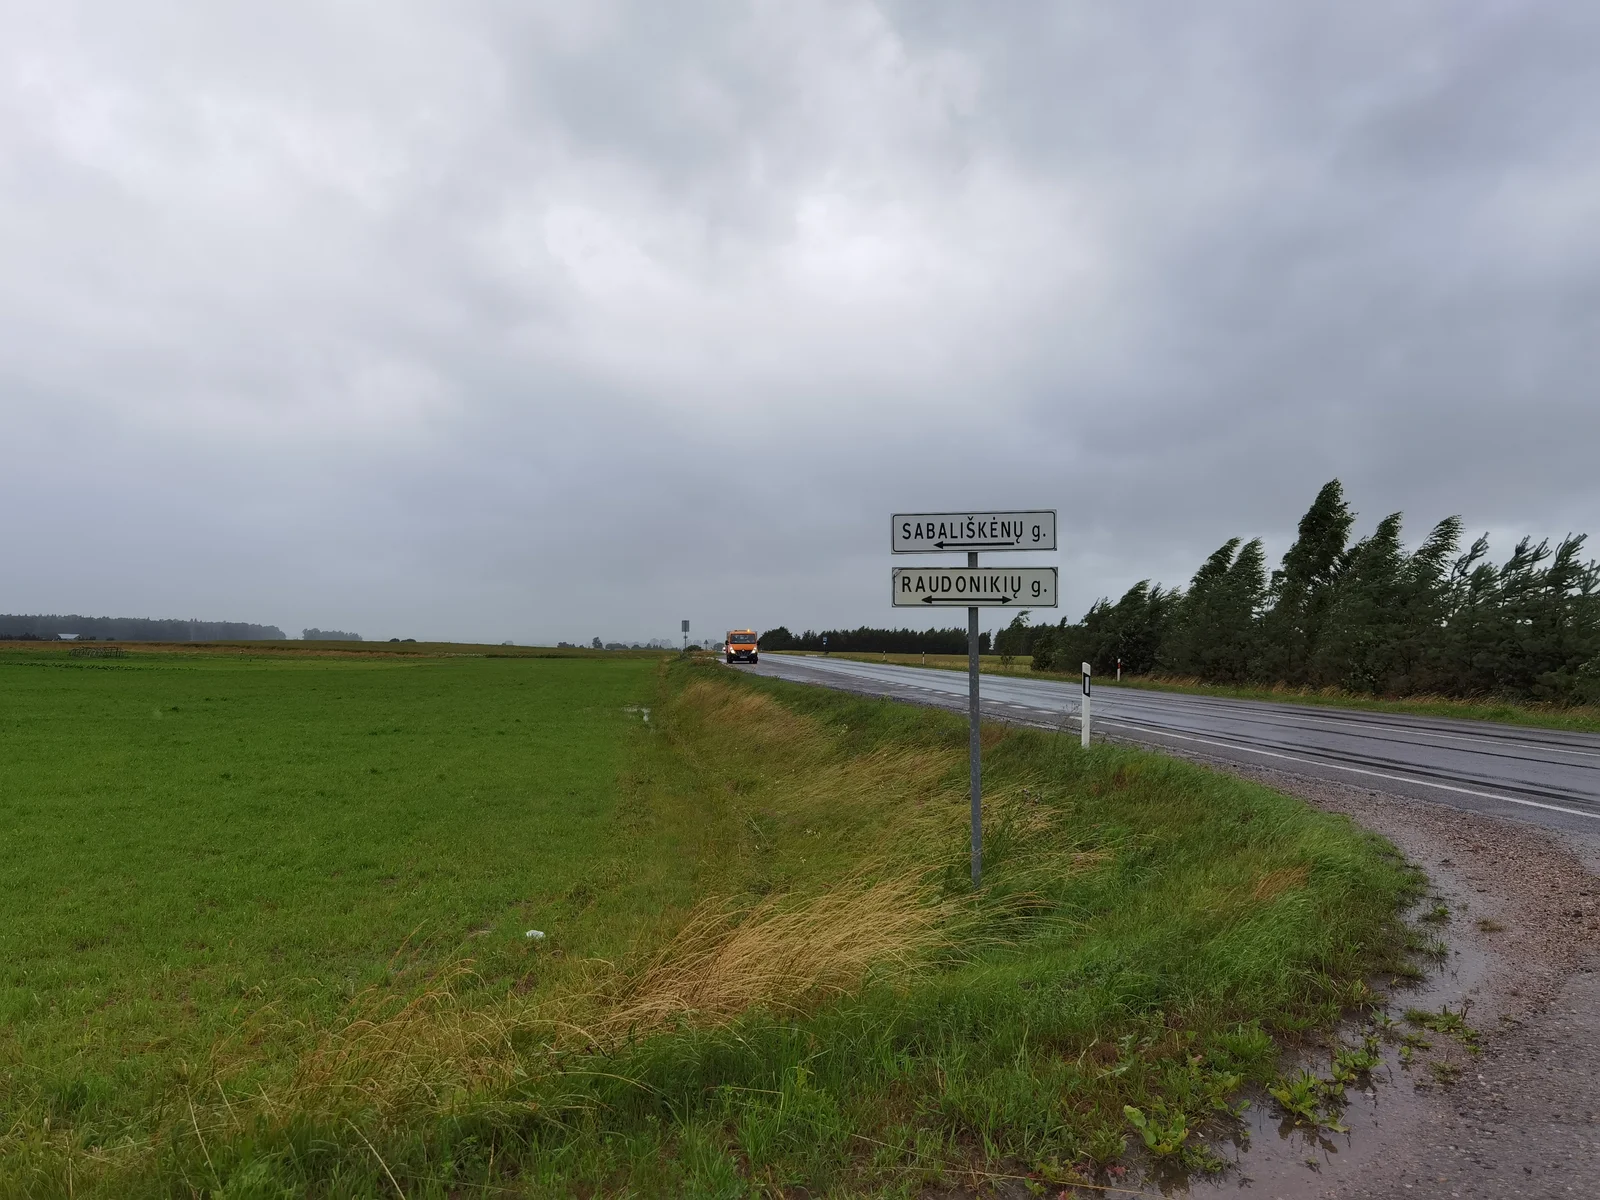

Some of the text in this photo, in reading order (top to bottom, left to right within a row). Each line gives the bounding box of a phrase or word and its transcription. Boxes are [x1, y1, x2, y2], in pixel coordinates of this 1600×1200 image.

[902, 516, 1046, 544] SABALIŠKĖNŲ g.
[902, 575, 1048, 599] RAUDONIKIŲ g.
